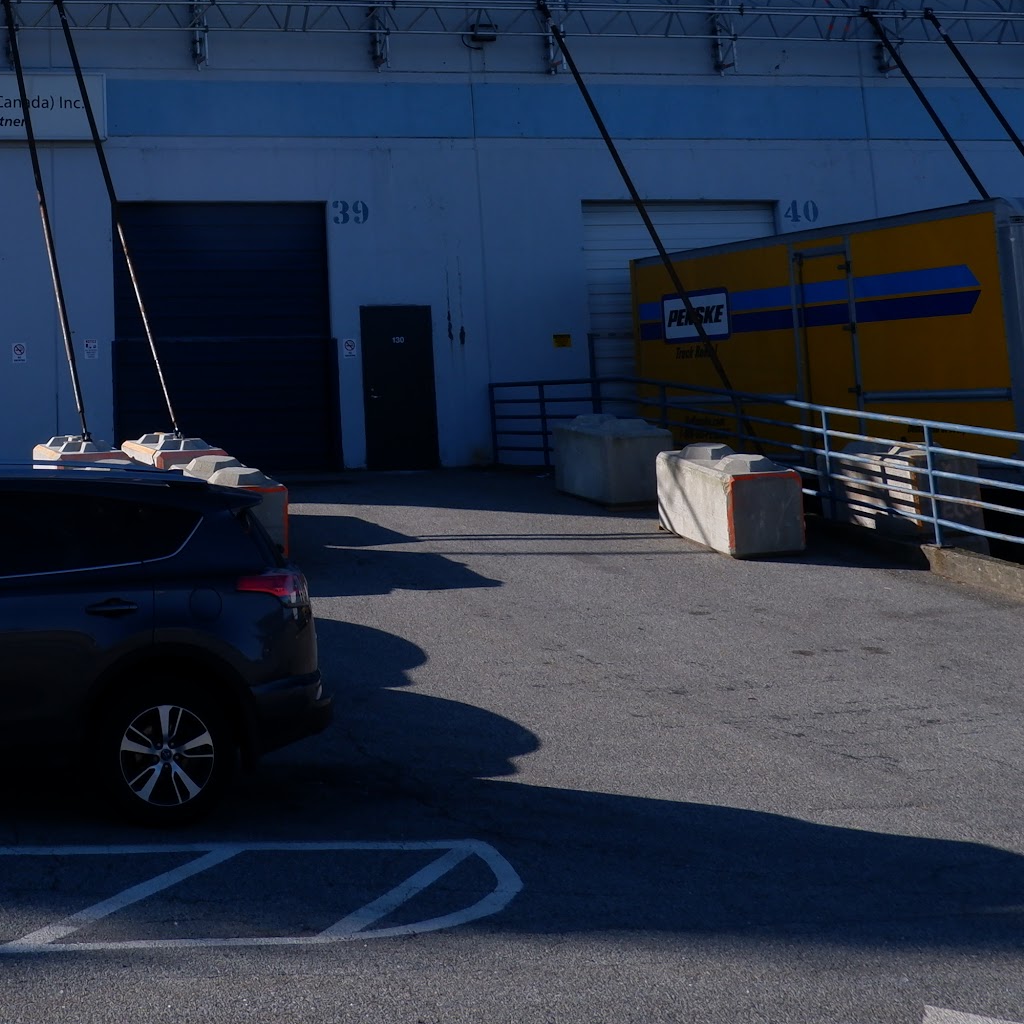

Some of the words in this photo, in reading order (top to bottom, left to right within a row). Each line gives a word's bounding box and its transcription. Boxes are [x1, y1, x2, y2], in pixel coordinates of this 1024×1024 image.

[59, 96, 85, 109] Inc.
[332, 200, 369, 224] 39
[783, 199, 819, 223] 40
[392, 336, 405, 344] 130
